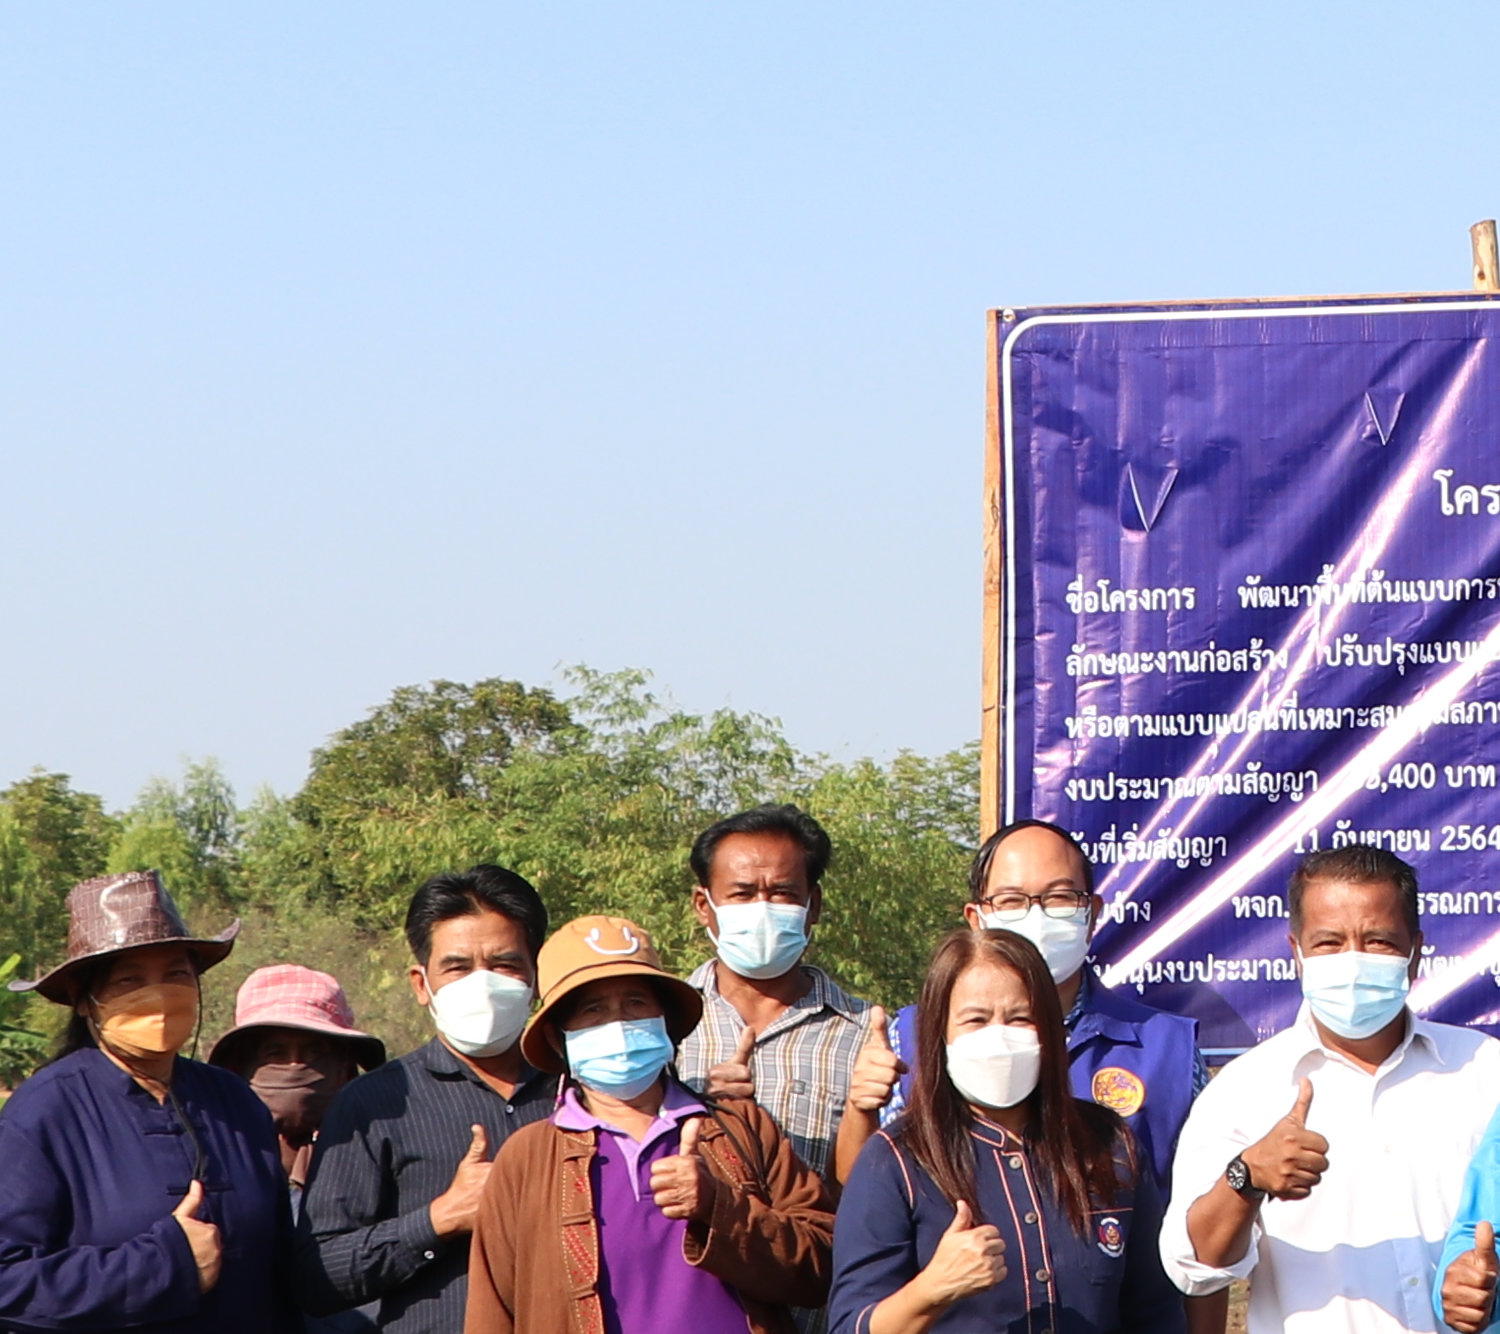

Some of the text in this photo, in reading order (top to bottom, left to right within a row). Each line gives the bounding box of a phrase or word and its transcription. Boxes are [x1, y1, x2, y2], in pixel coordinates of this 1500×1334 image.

[1065, 574, 1196, 614] ชื่อโครงการ
[1065, 638, 1289, 677] ลักษณะงานก่อสร้าง
[1064, 761, 1319, 803] งบประมาณตามสัญญา
[1445, 764, 1496, 788] บาท
[1072, 824, 1228, 868] ันที่เริ่มสัญญา
